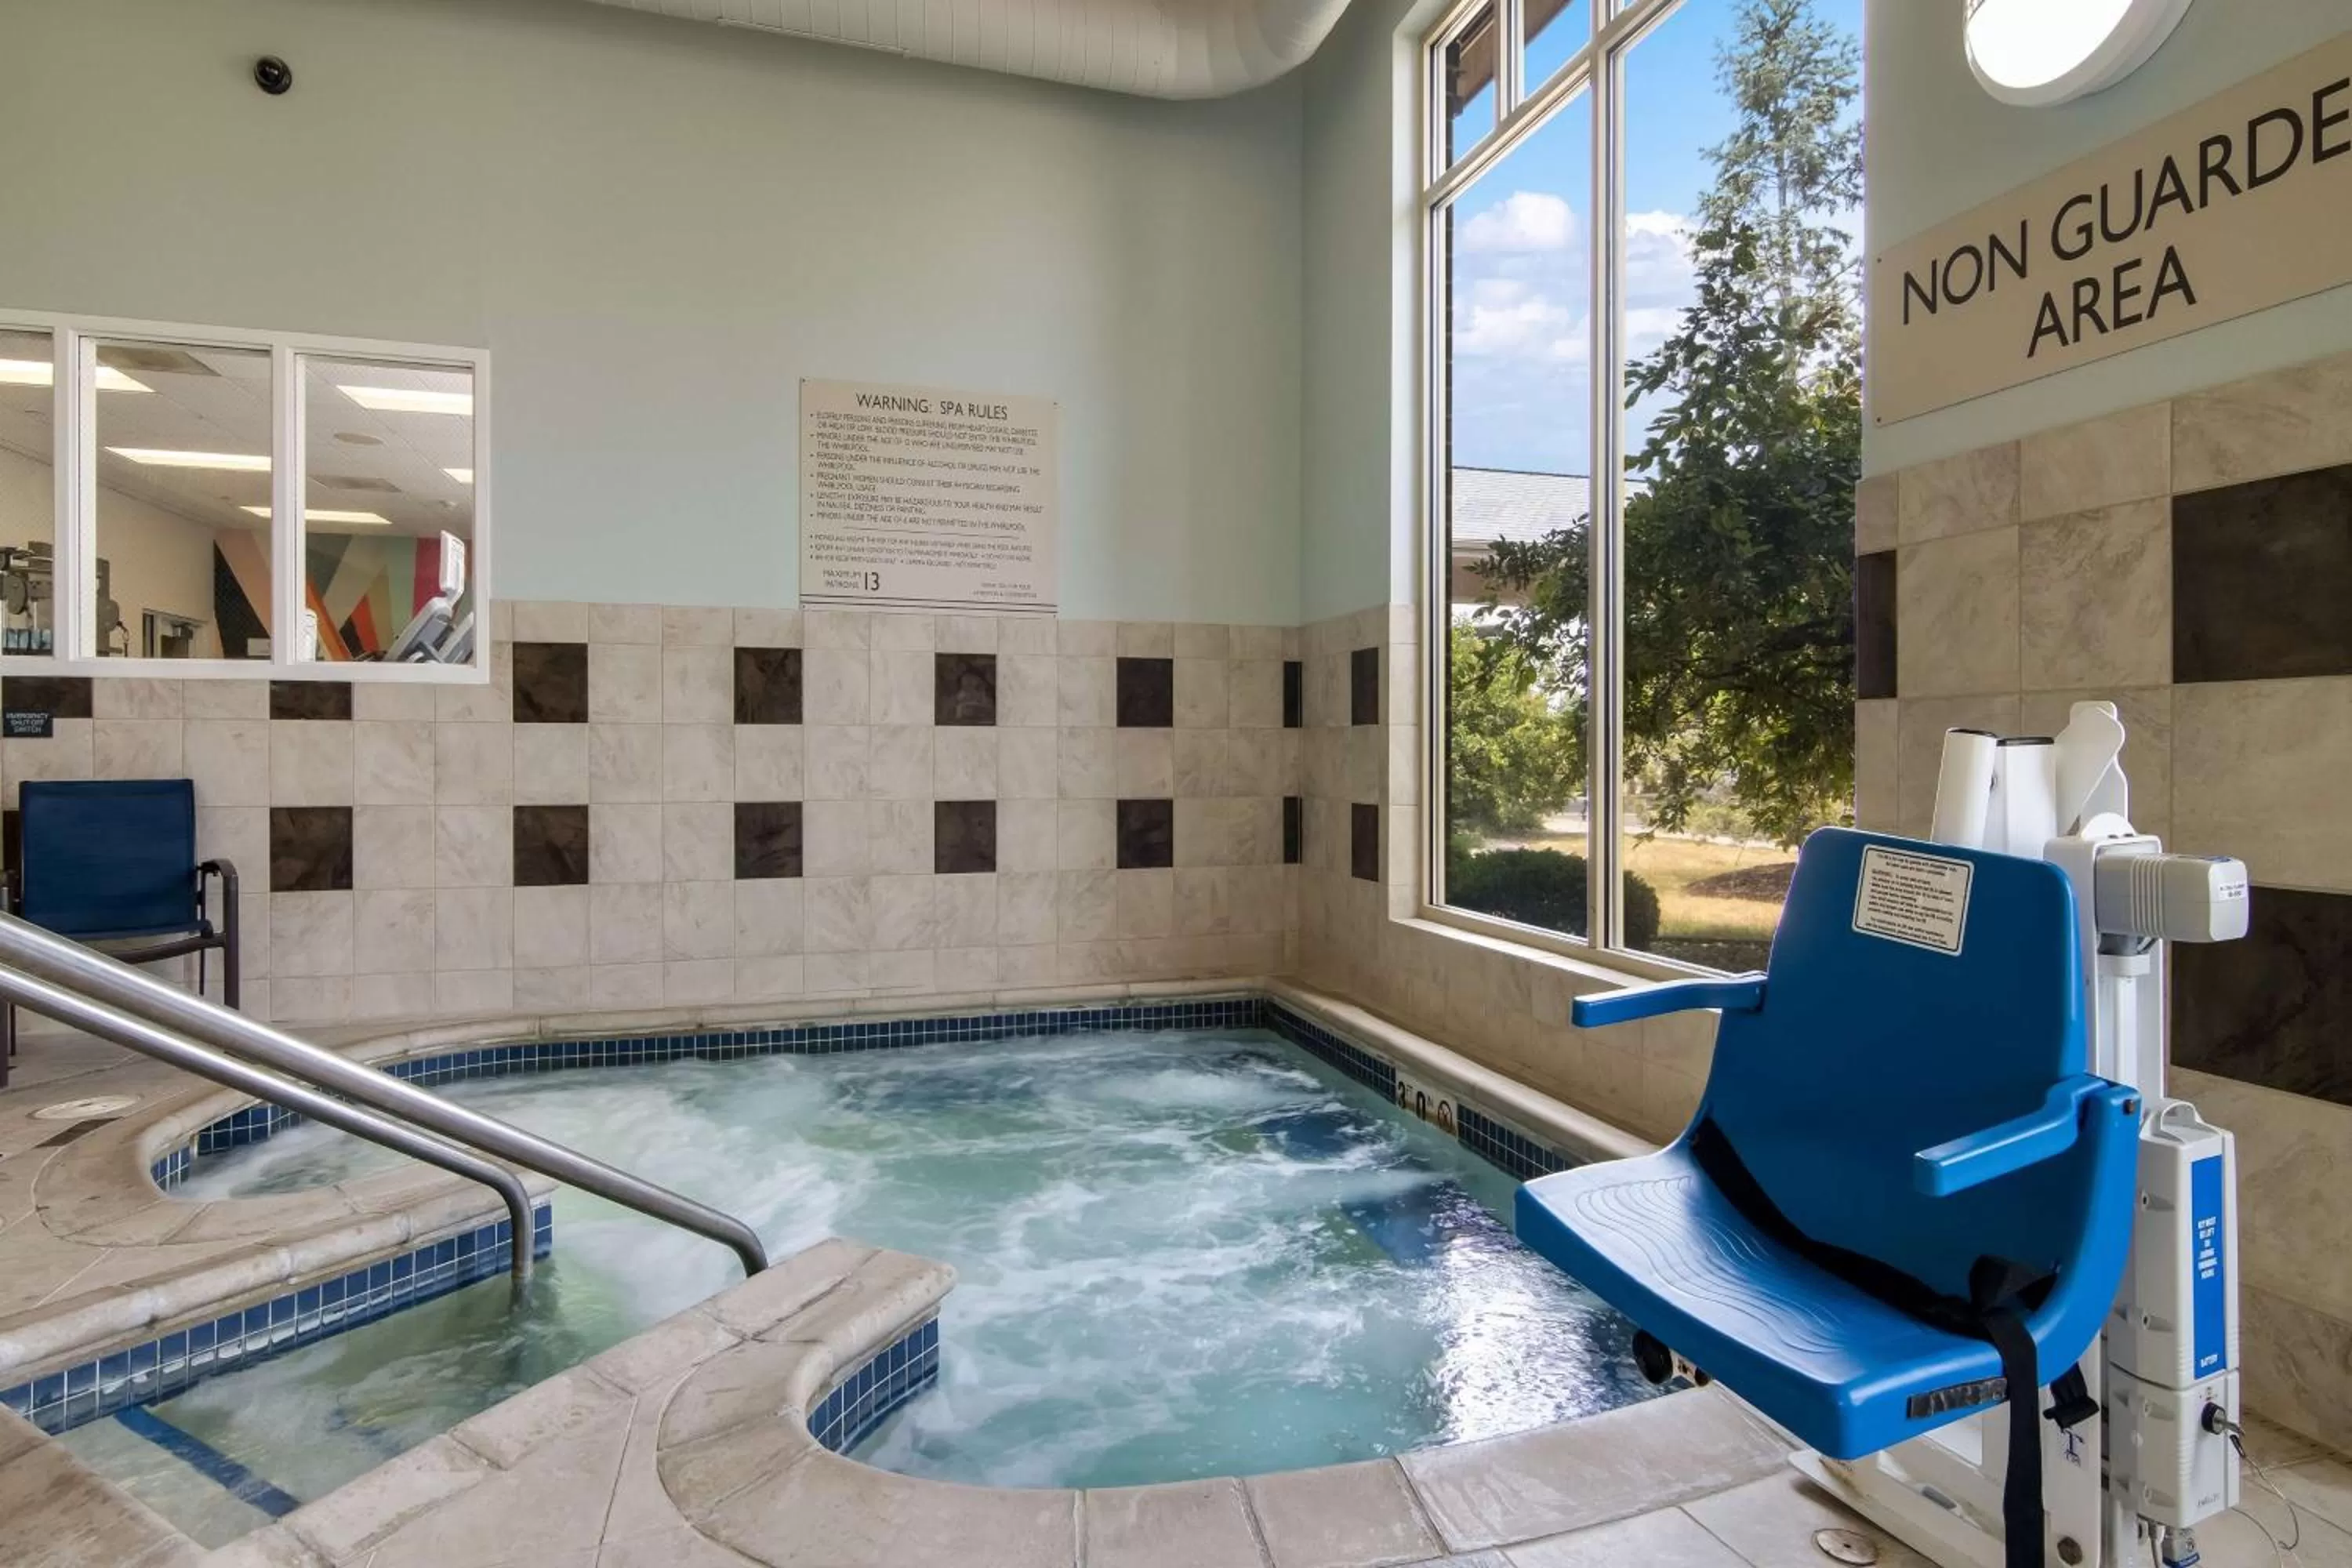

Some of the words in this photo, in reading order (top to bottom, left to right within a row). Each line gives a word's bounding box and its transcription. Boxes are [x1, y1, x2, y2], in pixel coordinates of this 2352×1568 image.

[1903, 219, 2028, 326] NON
[2050, 76, 2352, 262] GUARDE
[2027, 244, 2198, 359] AREA
[855, 393, 932, 414] WARNING:
[940, 401, 964, 416] SPA
[968, 402, 1008, 421] RULES
[865, 572, 880, 591] 13
[1398, 1080, 1406, 1109] 3
